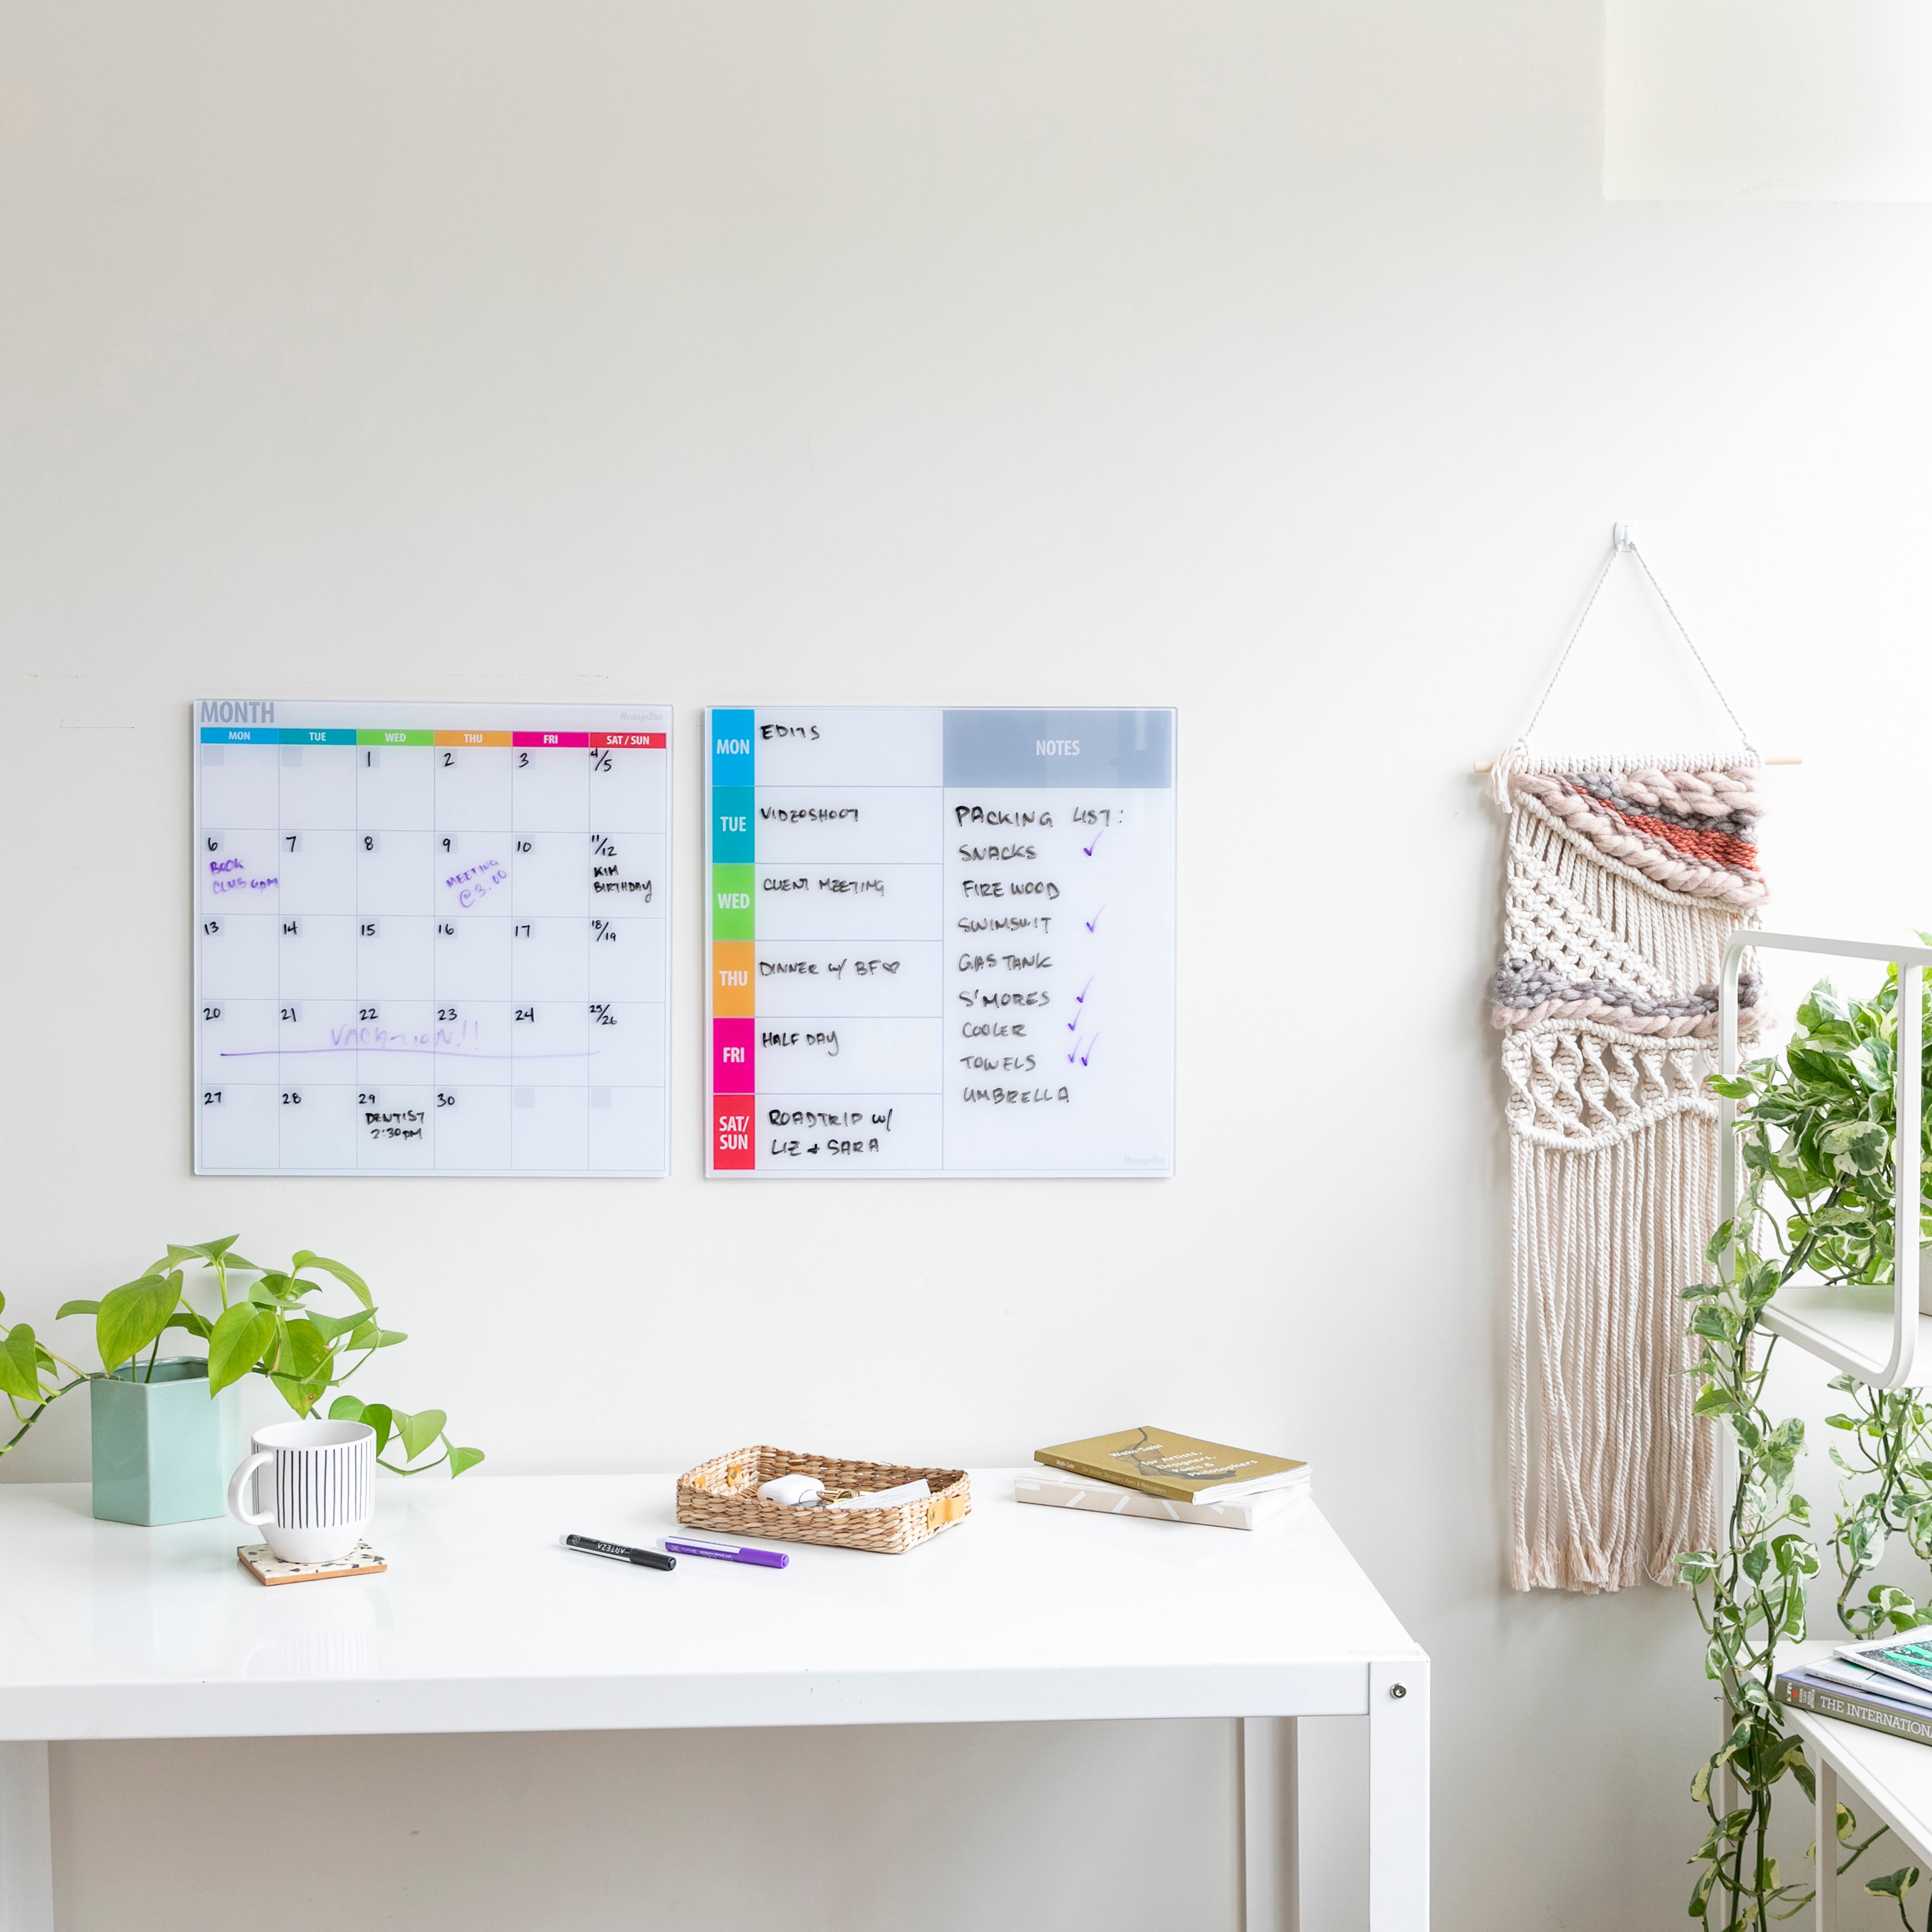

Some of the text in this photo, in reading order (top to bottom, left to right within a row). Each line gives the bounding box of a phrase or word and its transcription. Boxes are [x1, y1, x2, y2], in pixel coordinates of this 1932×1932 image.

[201, 701, 275, 723] MONTH
[228, 731, 251, 740] MON
[309, 732, 326, 741] TUE
[385, 733, 406, 742] WED
[464, 734, 483, 743] THU
[543, 735, 558, 744] FRI
[760, 724, 820, 740] EDITS
[606, 735, 650, 745] SAT / SUN
[716, 739, 750, 754] MON
[1036, 740, 1080, 755] NOTES
[368, 751, 370, 767] 1
[444, 753, 455, 767] 2
[519, 753, 529, 767] 3
[760, 808, 858, 822] VIDEOSHOOT
[955, 806, 1123, 826] PACKING LIST:
[720, 816, 746, 832] TUE
[208, 838, 218, 851] 6
[286, 836, 297, 852] 7
[365, 836, 373, 850] 8
[442, 838, 451, 852] 9
[517, 841, 532, 852] 10
[958, 843, 1038, 861] SNACKS
[446, 859, 500, 888] MEETING
[594, 865, 619, 877] KIM
[213, 877, 247, 894] CLUB
[594, 880, 652, 903] BIRTHDAY
[763, 878, 884, 896] CLIENT MEETING
[963, 880, 1060, 900] FIRE WOOD
[718, 893, 750, 909] WED
[204, 922, 219, 934] 13
[284, 921, 298, 934] 14
[361, 923, 375, 936] 15
[439, 924, 455, 935] 16
[515, 925, 530, 937] 17
[958, 916, 1051, 934] SWIMSUIT
[759, 961, 819, 976] DINNER
[855, 960, 881, 975] BF
[958, 952, 1052, 972] GAS TANK
[719, 970, 748, 986] THU
[959, 989, 1051, 1009] S'MORES
[203, 1008, 221, 1020] 20
[281, 1008, 297, 1022] 21
[359, 1009, 379, 1020] 22
[437, 1009, 457, 1021] 23
[515, 1008, 534, 1023] 24
[963, 1022, 1027, 1038] COOLER
[763, 1031, 839, 1056] HALF DAY
[723, 1047, 745, 1063] FRI
[960, 1054, 1037, 1071] TOWELS
[204, 1092, 222, 1105] 27
[282, 1093, 301, 1104] 28
[358, 1094, 375, 1104] 29
[437, 1094, 455, 1107] 30
[964, 1086, 1069, 1104] UMBRELLA
[366, 1110, 425, 1124] DENTIST
[719, 1115, 749, 1132] SAT/
[769, 1109, 863, 1128] ROADTRIP
[720, 1134, 748, 1150] SUN
[771, 1139, 801, 1156] LIZ
[827, 1138, 879, 1155] SARA
[1108, 1444, 1164, 1457] Wabi-Sabi
[1172, 1464, 1203, 1473] Poets
[1187, 1460, 1258, 1477] Philosophers
[597, 1542, 626, 1554] ARTEZA
[1820, 1695, 1932, 1738] THE INTERNATION
